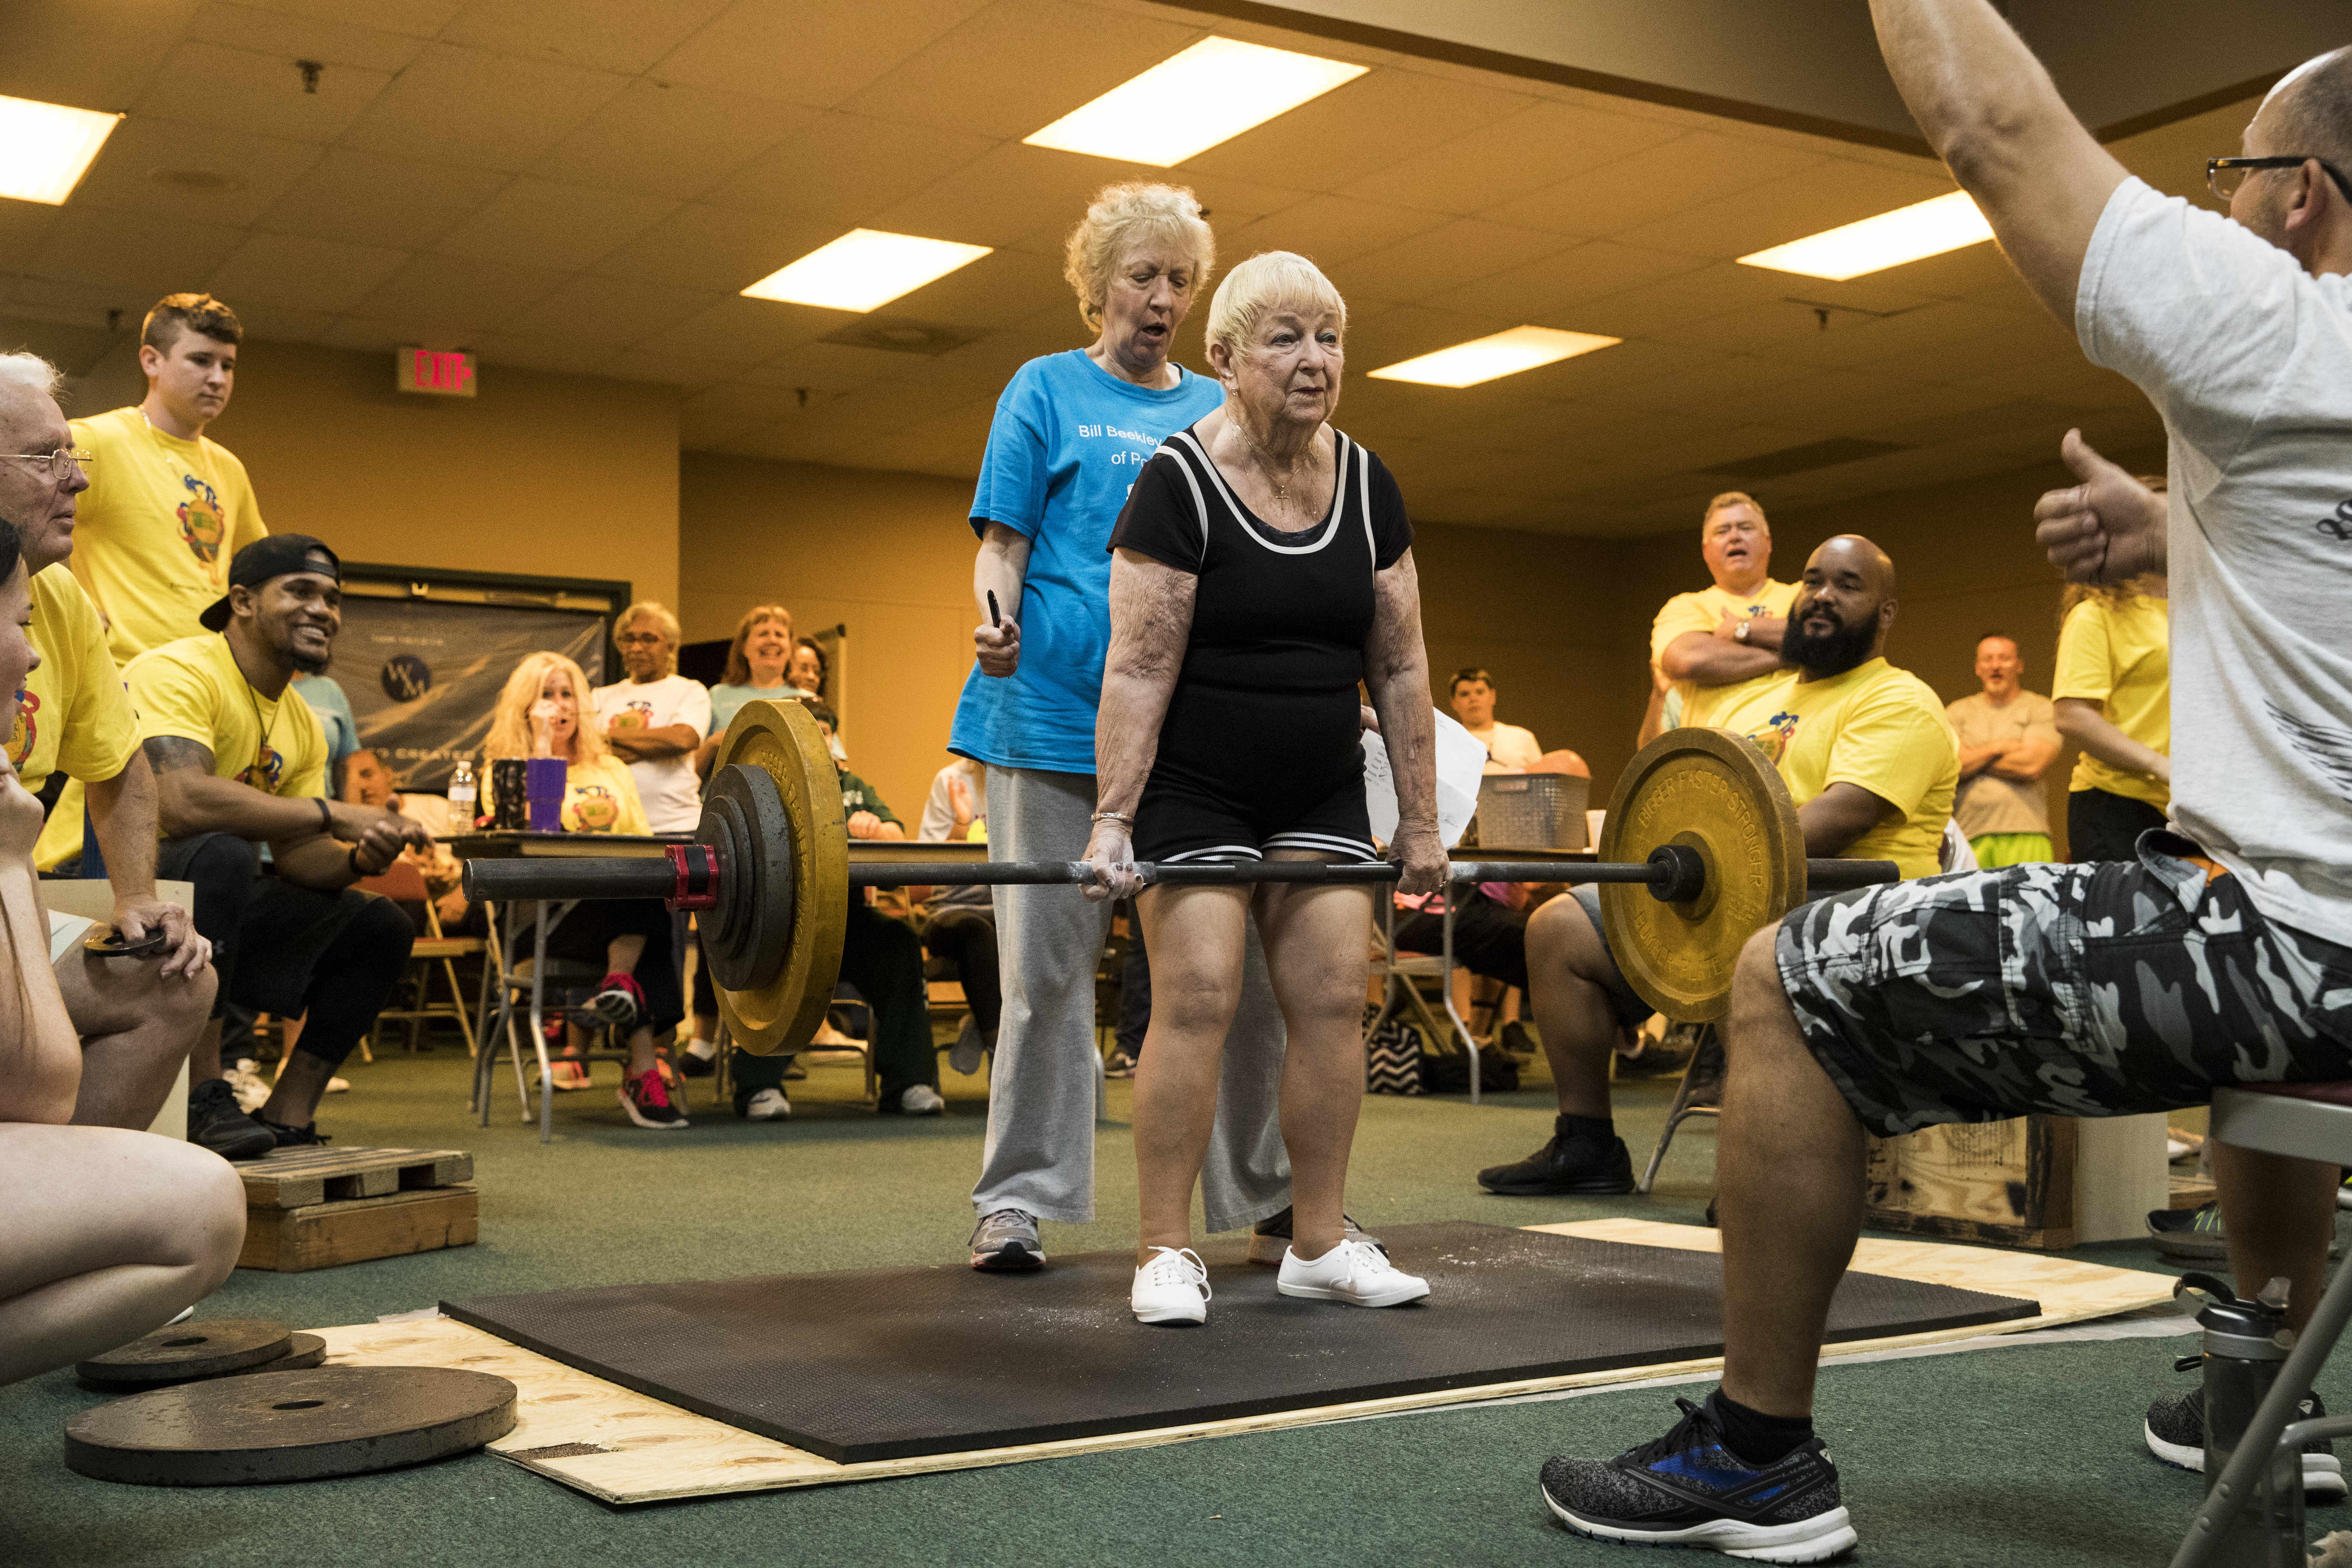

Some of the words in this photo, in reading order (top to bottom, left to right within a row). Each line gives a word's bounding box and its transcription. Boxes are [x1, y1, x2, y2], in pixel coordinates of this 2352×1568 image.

[416, 351, 465, 389] EXIT
[1079, 425, 1102, 438] Bill
[1106, 425, 1161, 448] Beekley
[1111, 451, 1127, 465] of
[1638, 778, 1675, 828] BIGGER
[1678, 770, 1728, 799] FASTER
[1727, 792, 1764, 888] STRONGER
